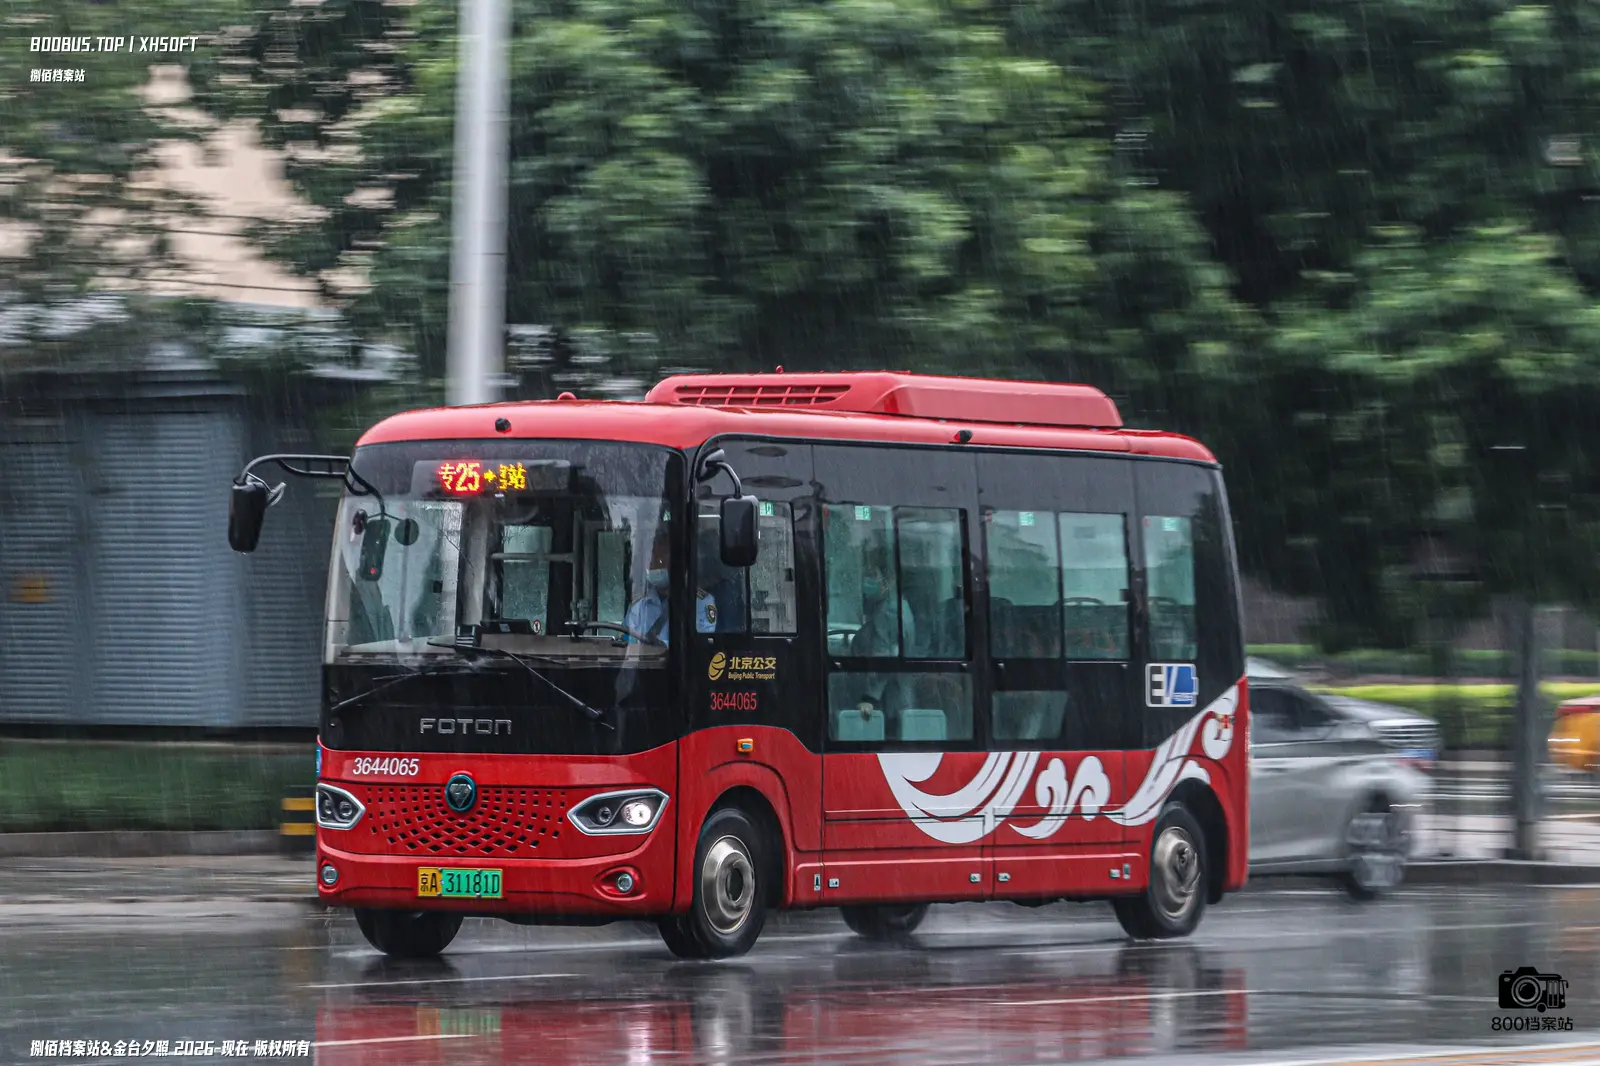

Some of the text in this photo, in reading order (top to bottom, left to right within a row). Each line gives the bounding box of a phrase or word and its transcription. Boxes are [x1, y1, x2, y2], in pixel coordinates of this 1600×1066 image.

[439, 462, 481, 491] 专25
[729, 656, 777, 670] 北京公交
[728, 671, 775, 680] Beijing Public Transport
[710, 692, 757, 711] 3644065
[419, 718, 513, 735] FOTON
[352, 757, 420, 776] 3644065
